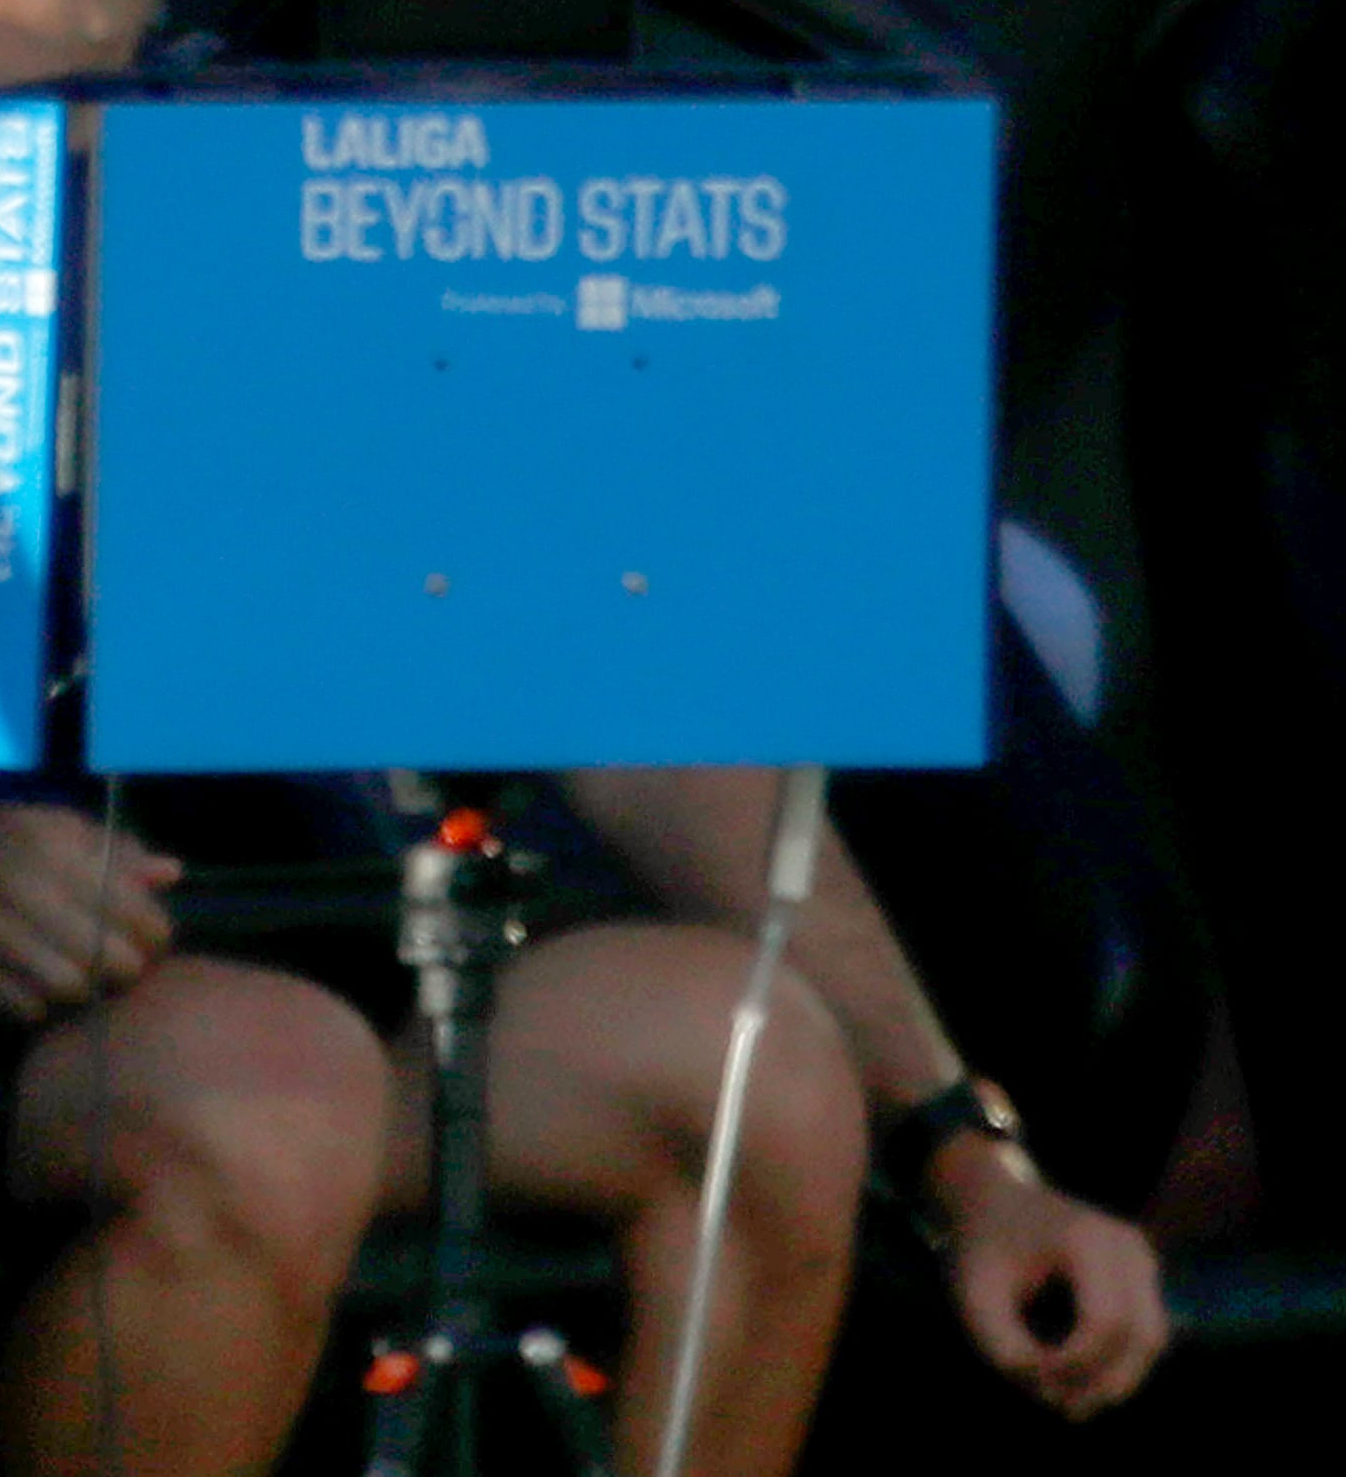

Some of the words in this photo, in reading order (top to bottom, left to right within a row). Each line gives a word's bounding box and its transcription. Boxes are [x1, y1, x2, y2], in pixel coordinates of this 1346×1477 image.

[301, 111, 490, 170] LALIGA
[300, 177, 565, 261] BEYOND
[576, 174, 789, 261] STATS
